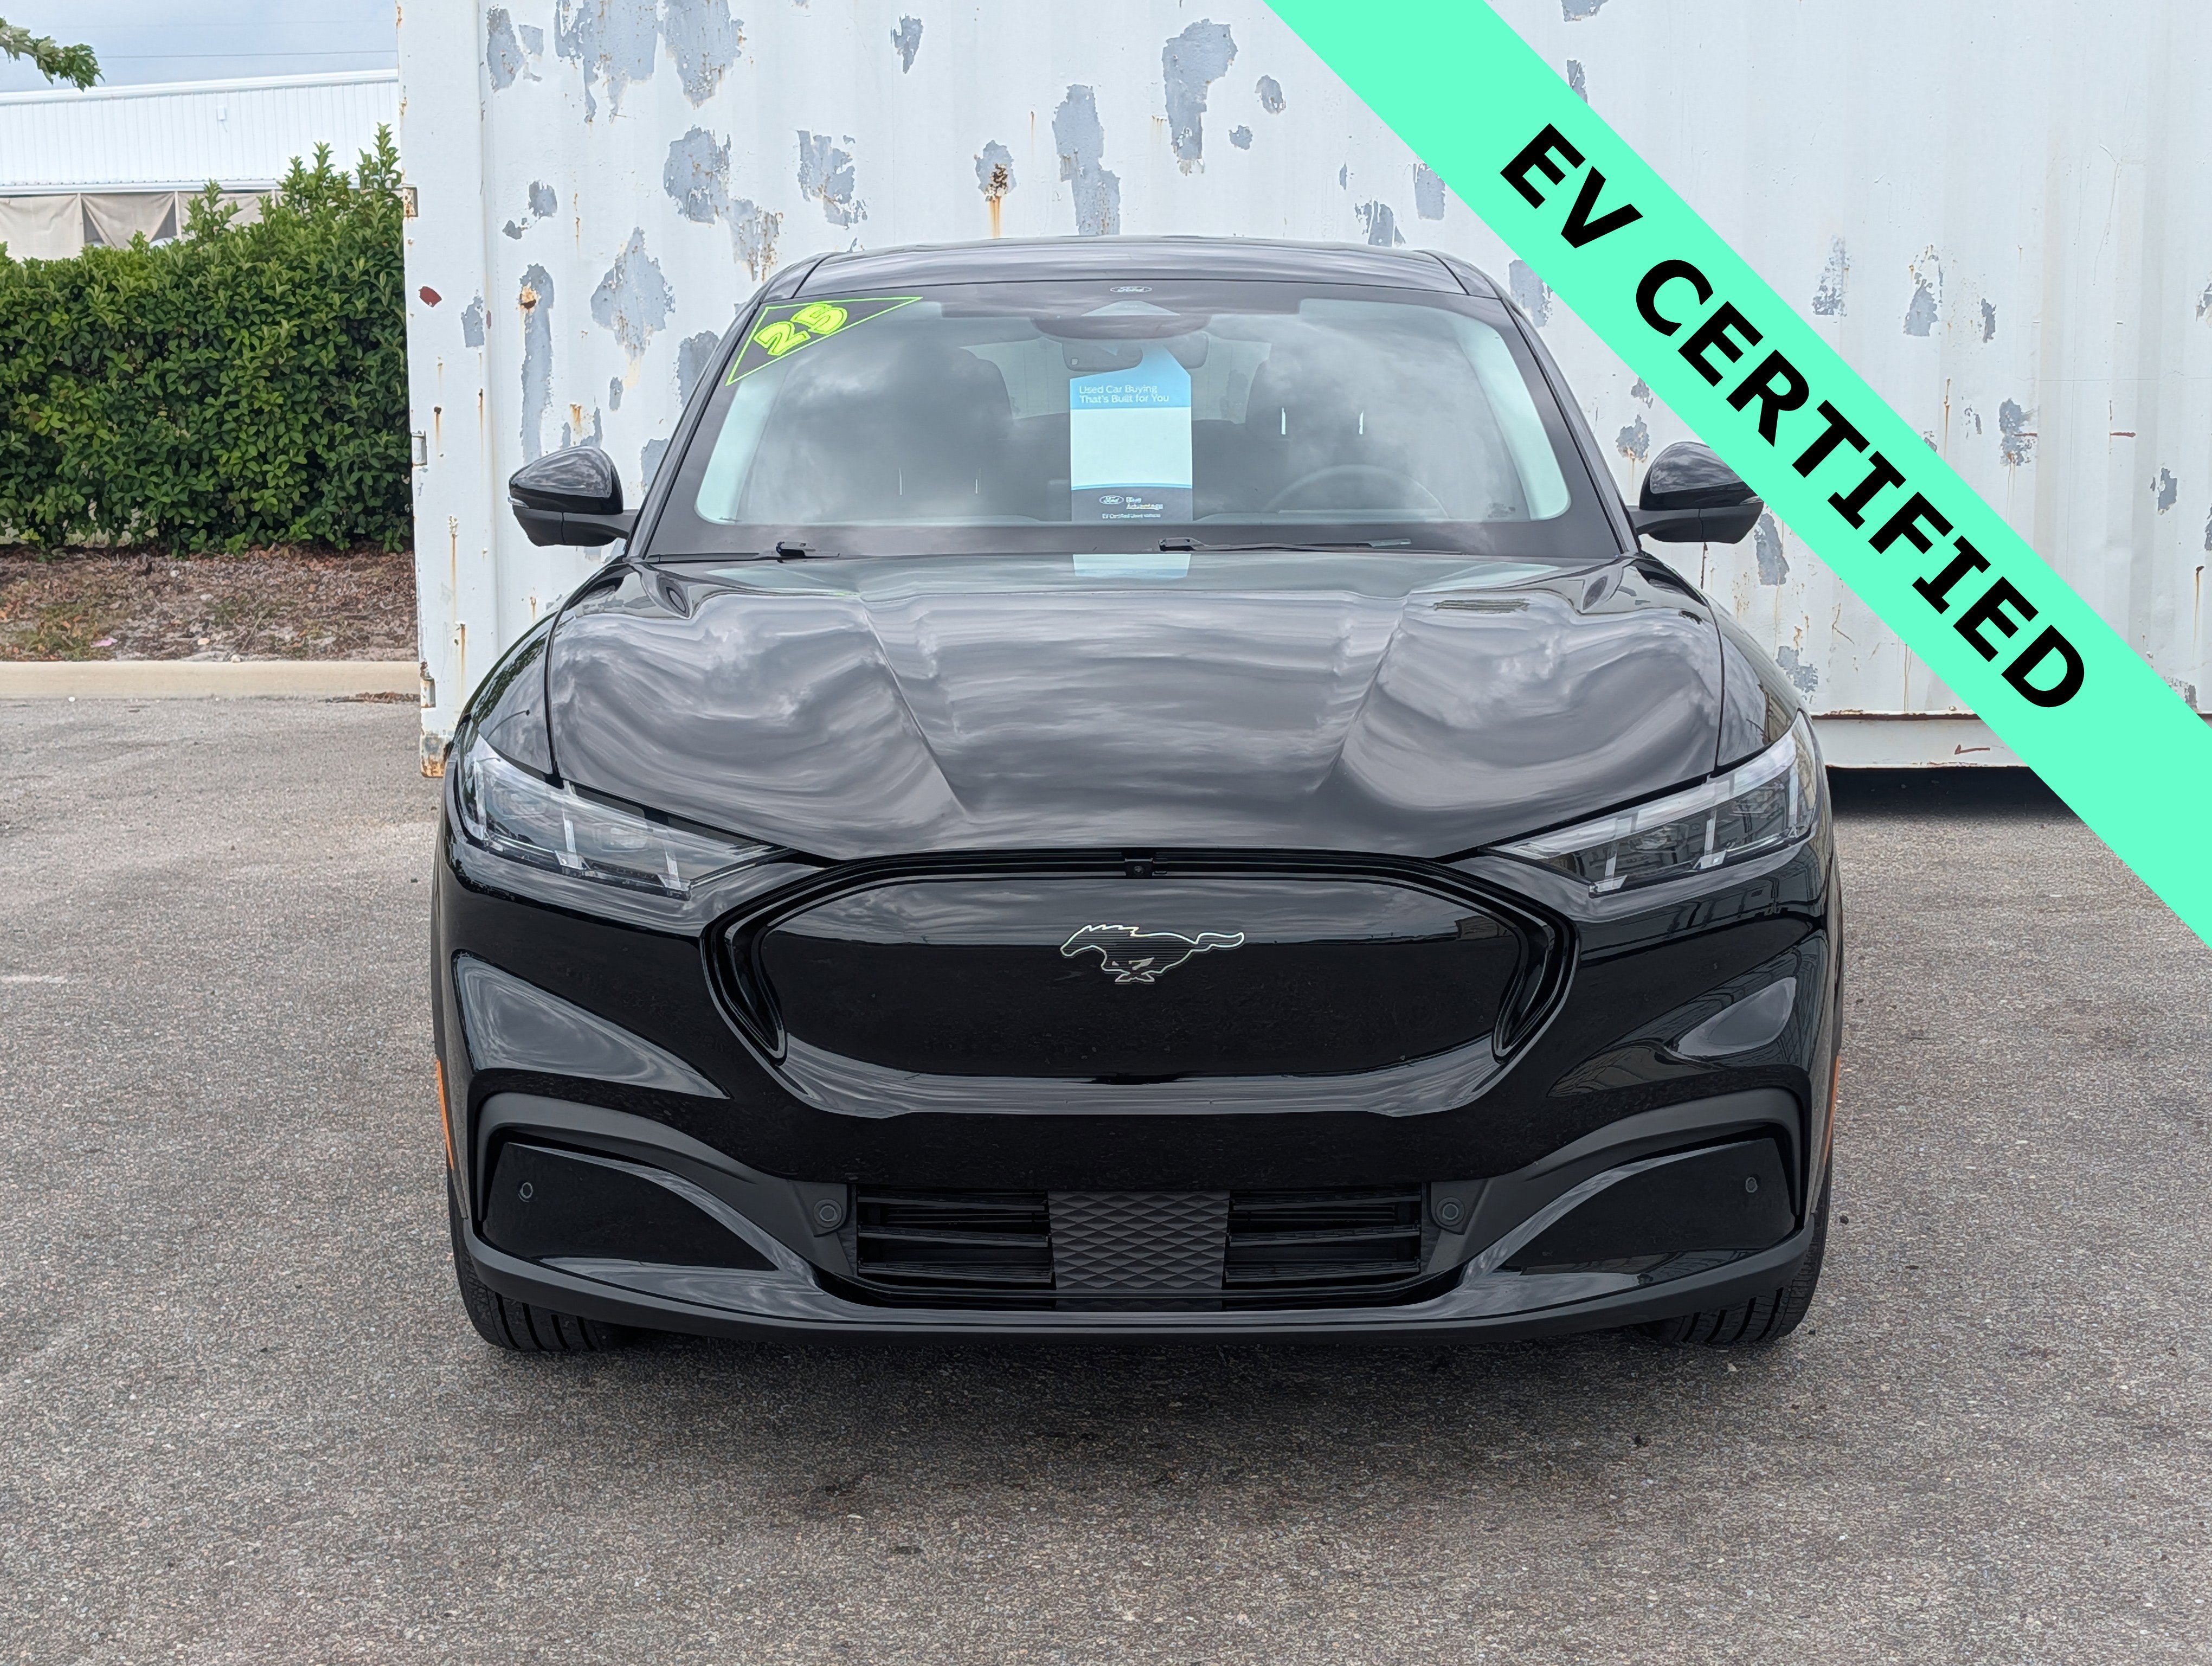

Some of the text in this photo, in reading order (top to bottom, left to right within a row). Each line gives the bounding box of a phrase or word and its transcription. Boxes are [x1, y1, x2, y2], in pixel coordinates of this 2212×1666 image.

[753, 303, 848, 356] 25
[1079, 384, 1158, 394] Used Car Buying
[1079, 394, 1169, 403] That's Built for You
